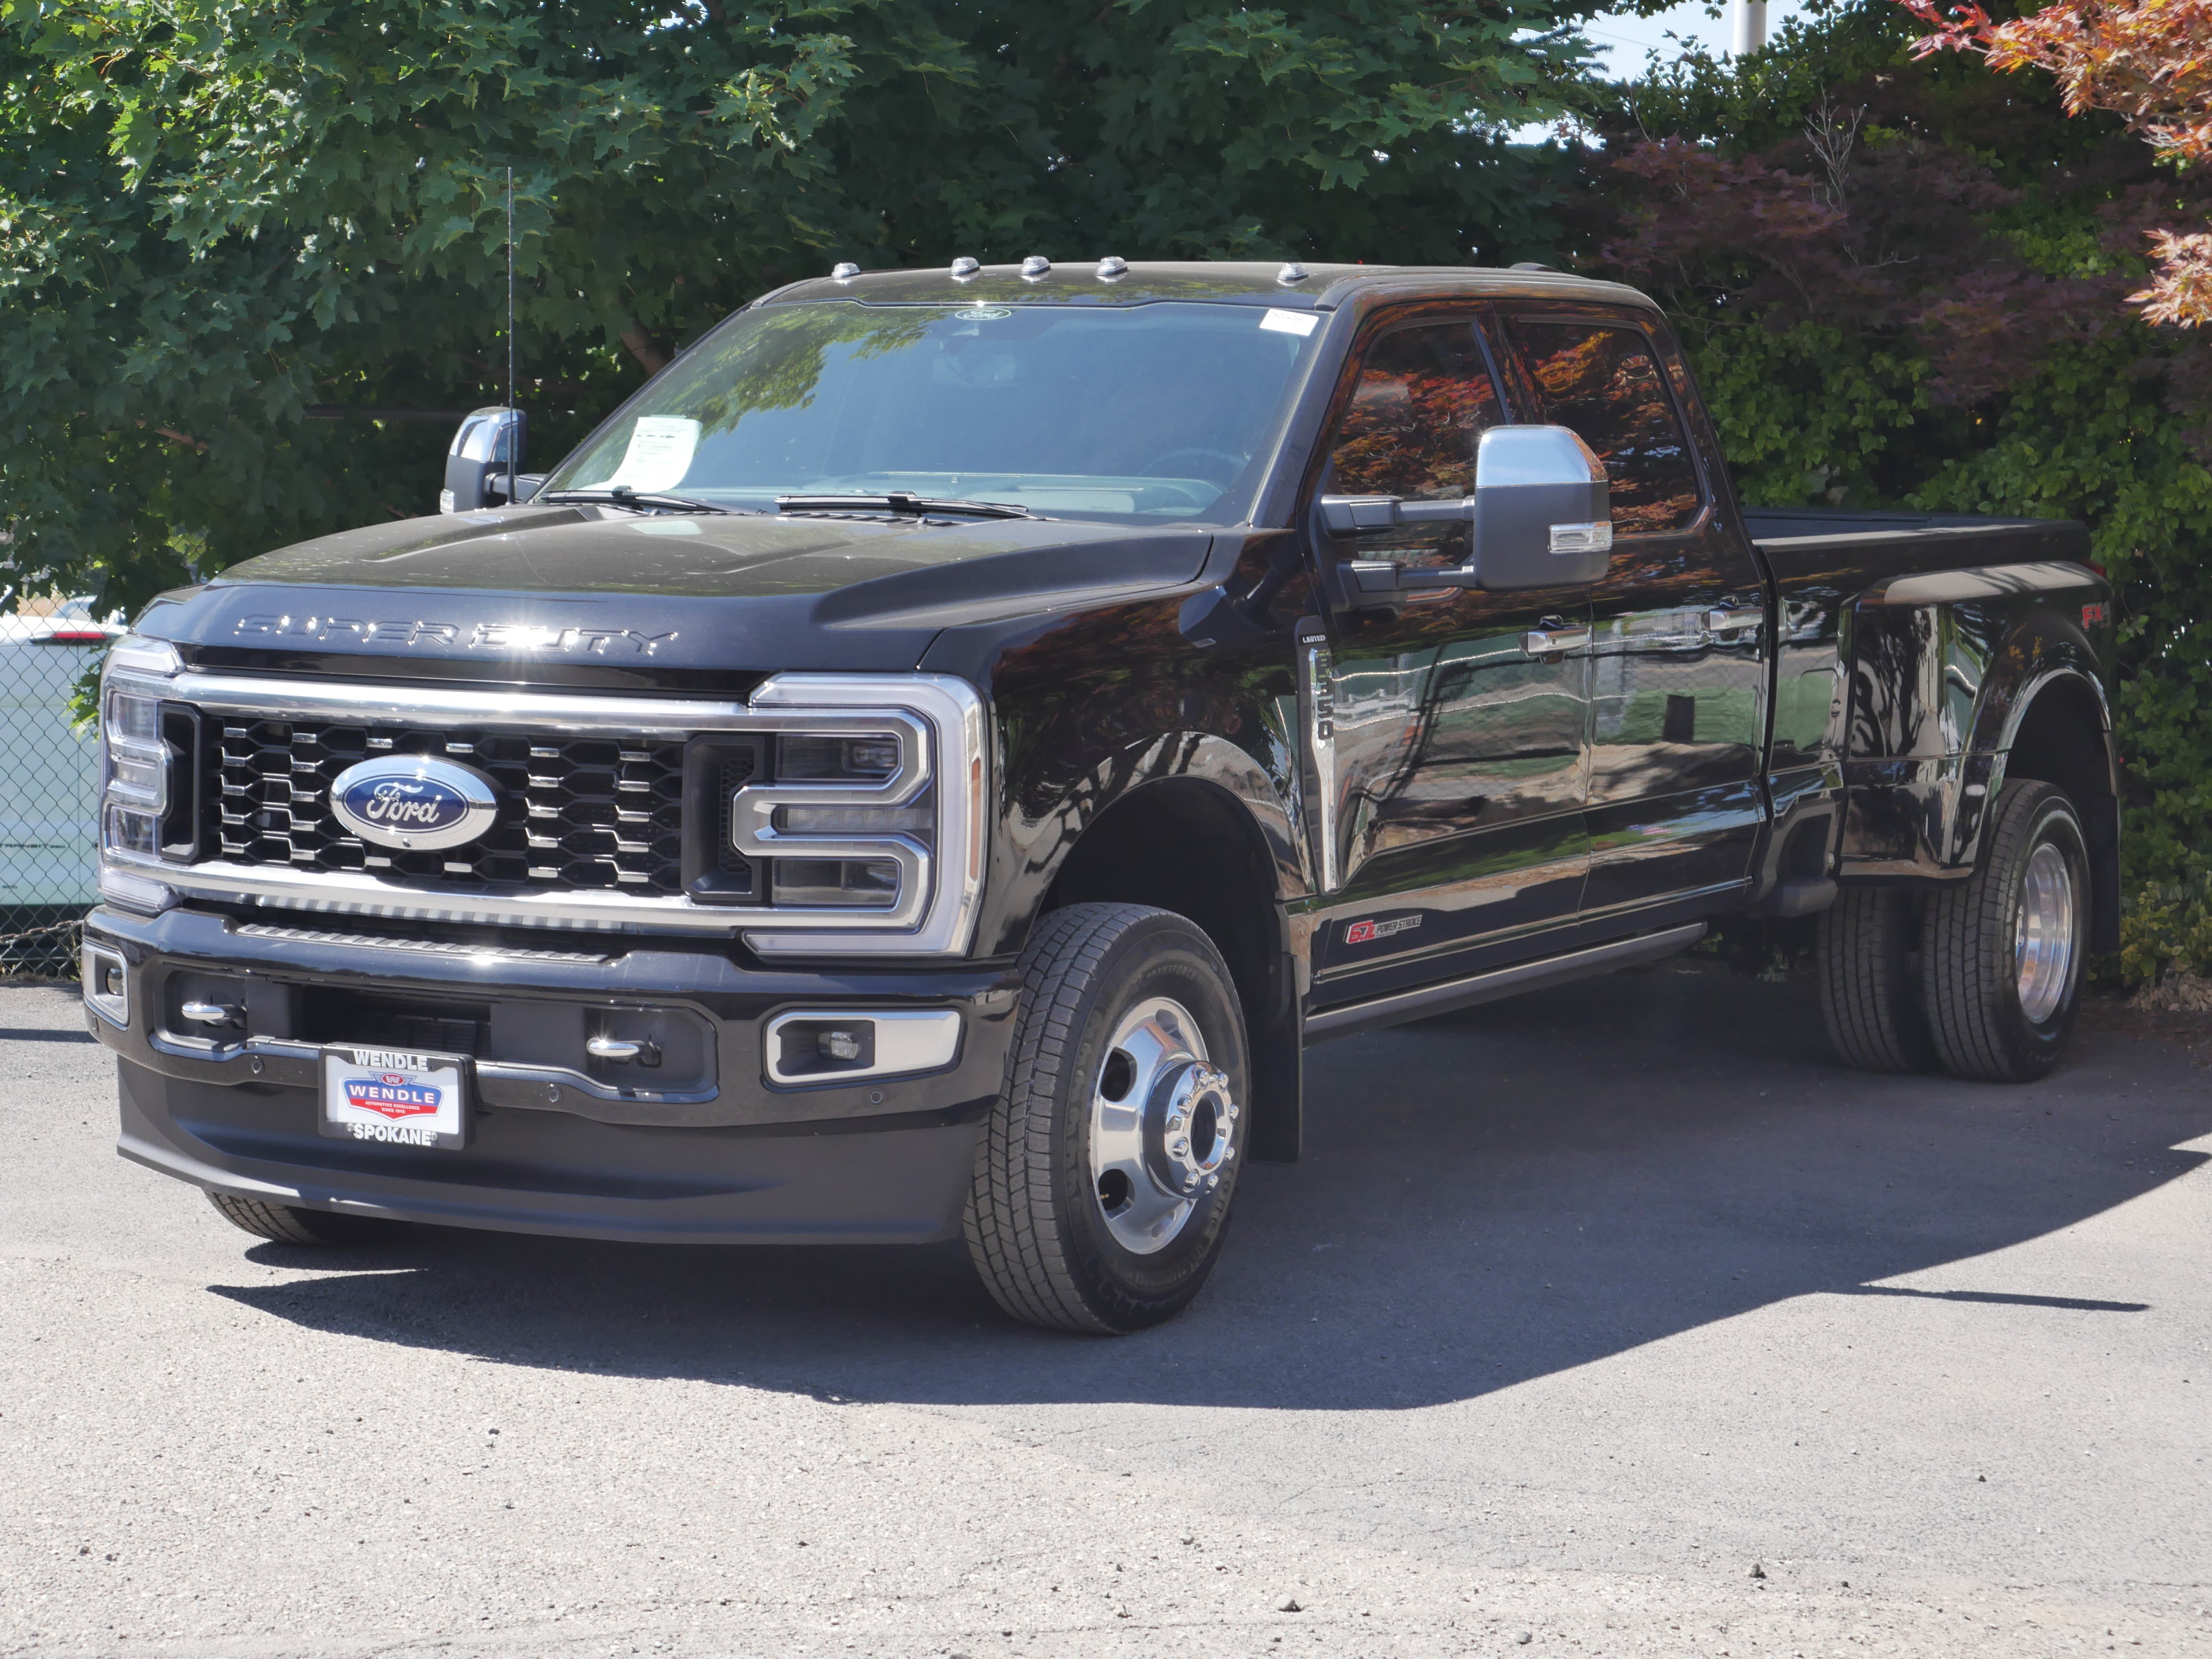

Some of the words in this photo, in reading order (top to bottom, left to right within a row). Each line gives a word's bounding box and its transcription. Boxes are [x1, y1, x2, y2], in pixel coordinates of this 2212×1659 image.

[964, 309, 1003, 318] Ford
[233, 614, 461, 645] SUPER
[1302, 635, 1326, 643] LIMITED
[366, 782, 442, 823] Ford
[1377, 921, 1397, 934] POWER
[353, 1051, 428, 1072] WENDLE
[349, 1085, 435, 1104] WENDLE
[353, 1123, 431, 1146] SPOKANE
